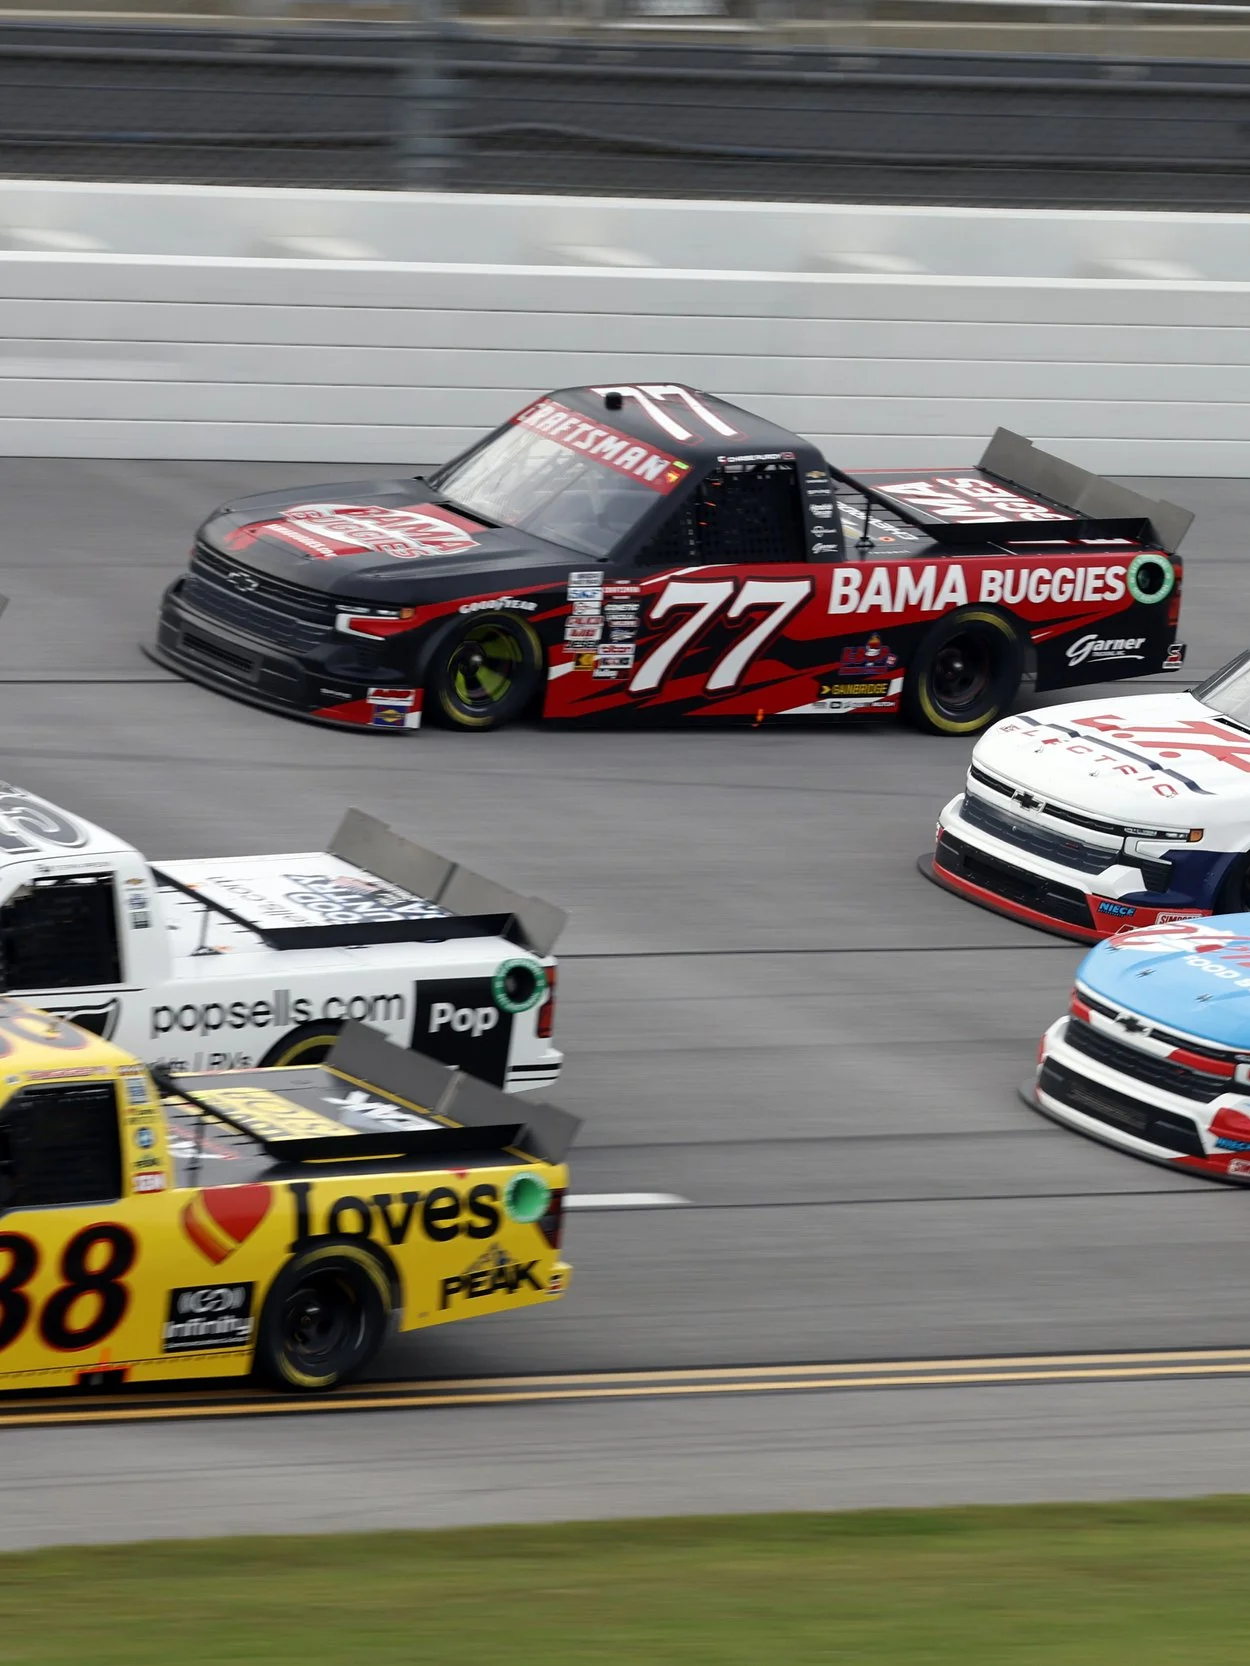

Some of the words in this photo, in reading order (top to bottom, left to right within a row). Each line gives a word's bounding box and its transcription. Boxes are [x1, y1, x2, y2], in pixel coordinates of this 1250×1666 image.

[587, 385, 742, 442] 77
[516, 403, 671, 482] CRAFTSMAN
[827, 564, 969, 614] BAMA
[980, 565, 1127, 604] BUGGIES
[628, 580, 812, 693] 77
[1065, 634, 1146, 667] Garner
[1099, 902, 1137, 916] NIECE
[150, 989, 405, 1039] popsells.com
[429, 1002, 498, 1037] Pop
[437, 1259, 546, 1311] PEAK
